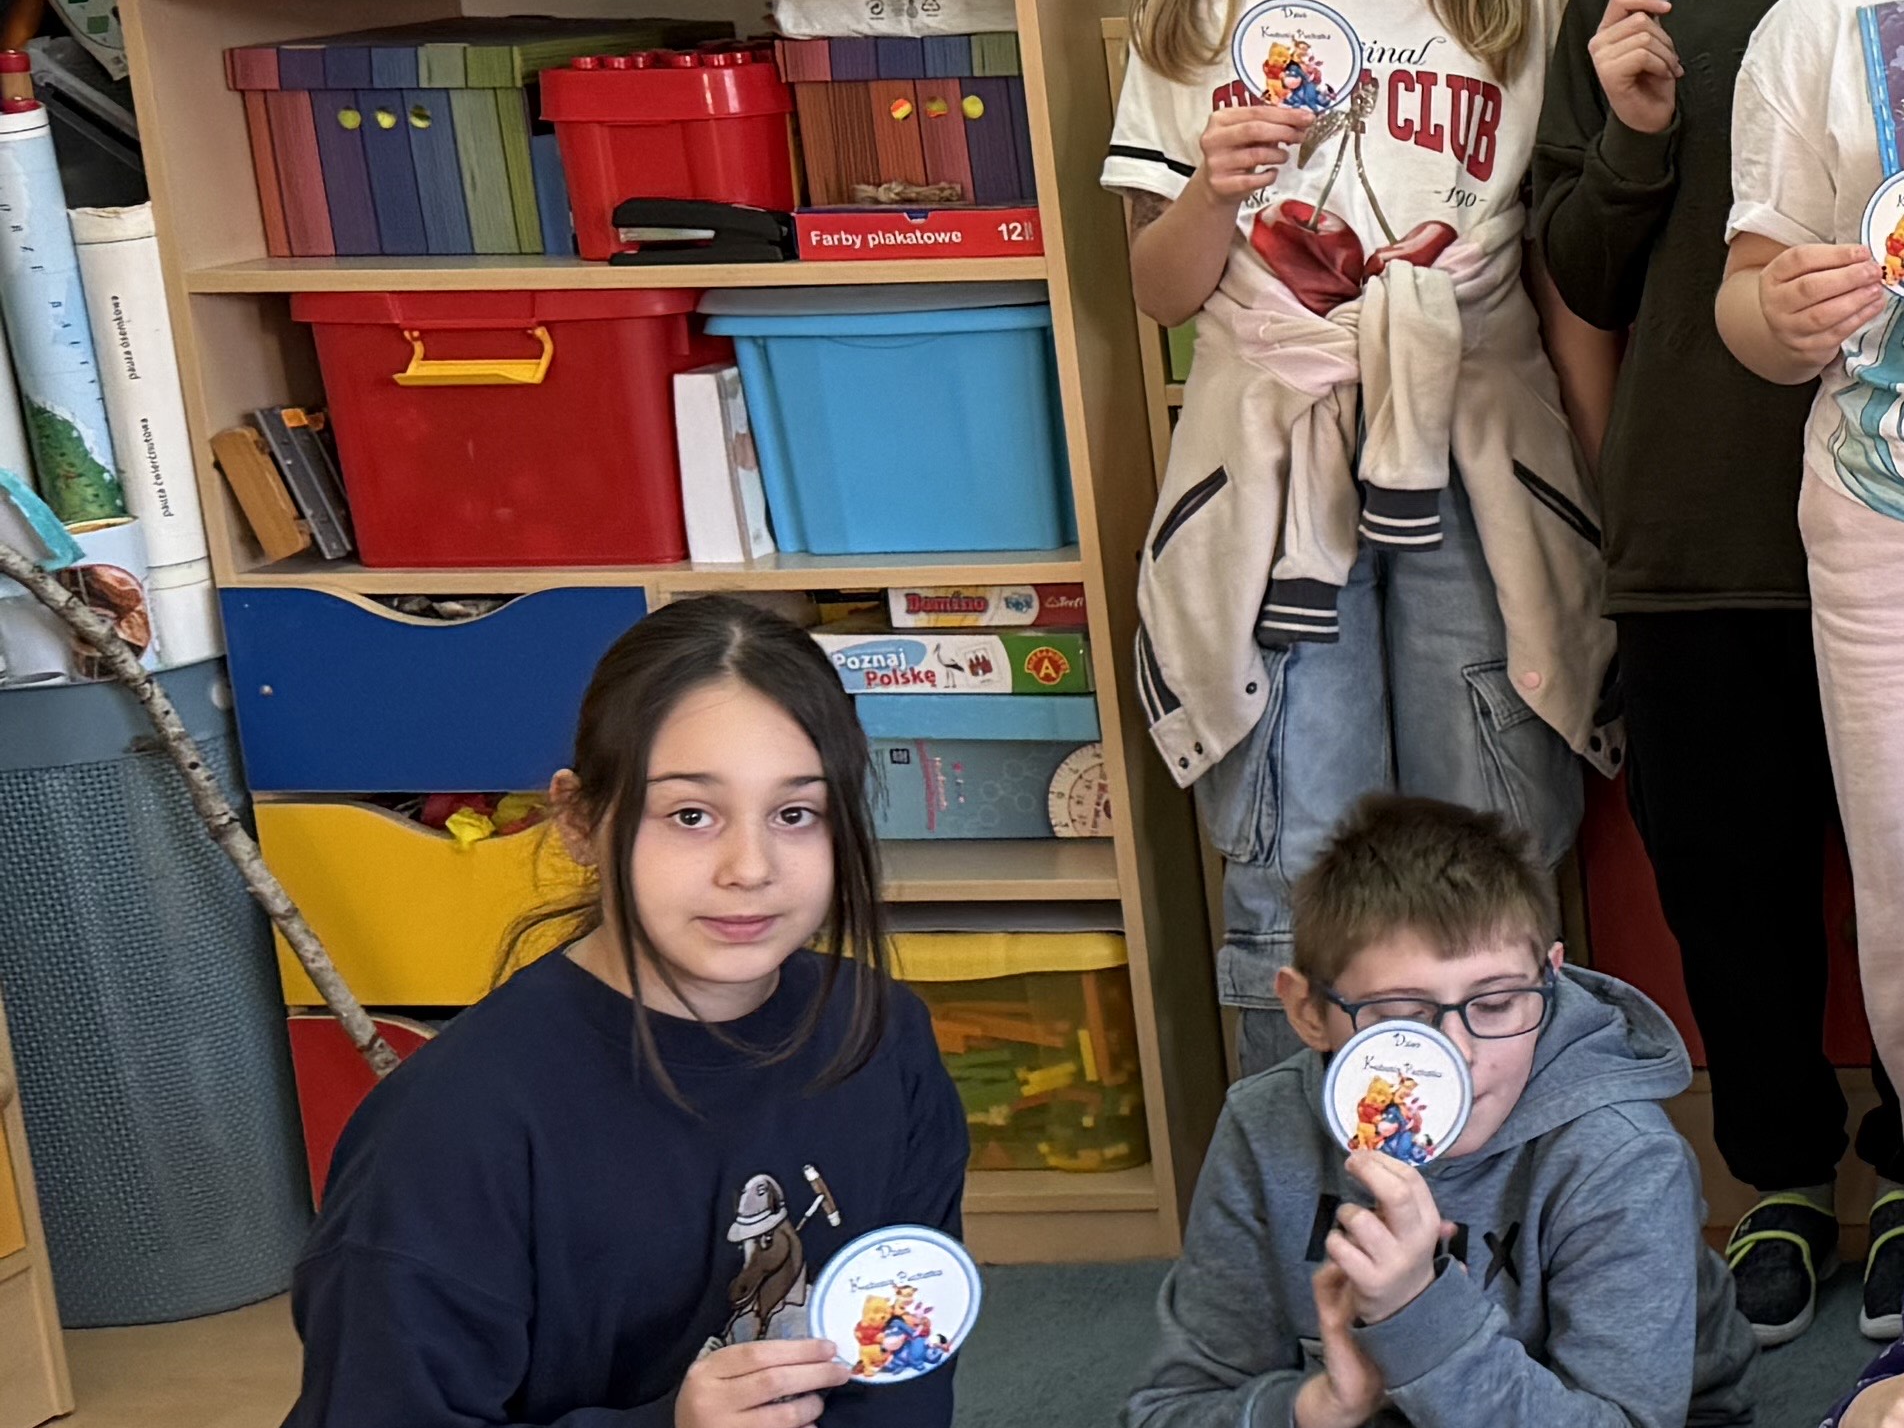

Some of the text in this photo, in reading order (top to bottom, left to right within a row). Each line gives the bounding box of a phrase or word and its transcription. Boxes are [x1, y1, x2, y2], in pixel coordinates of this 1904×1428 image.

[1388, 69, 1502, 182] CLUB
[811, 222, 1023, 249] Farby plakatowe 12
[905, 590, 989, 614] Domino
[831, 647, 906, 670] Poznaj
[865, 668, 936, 688] Polskę
[1040, 663, 1057, 678] A
